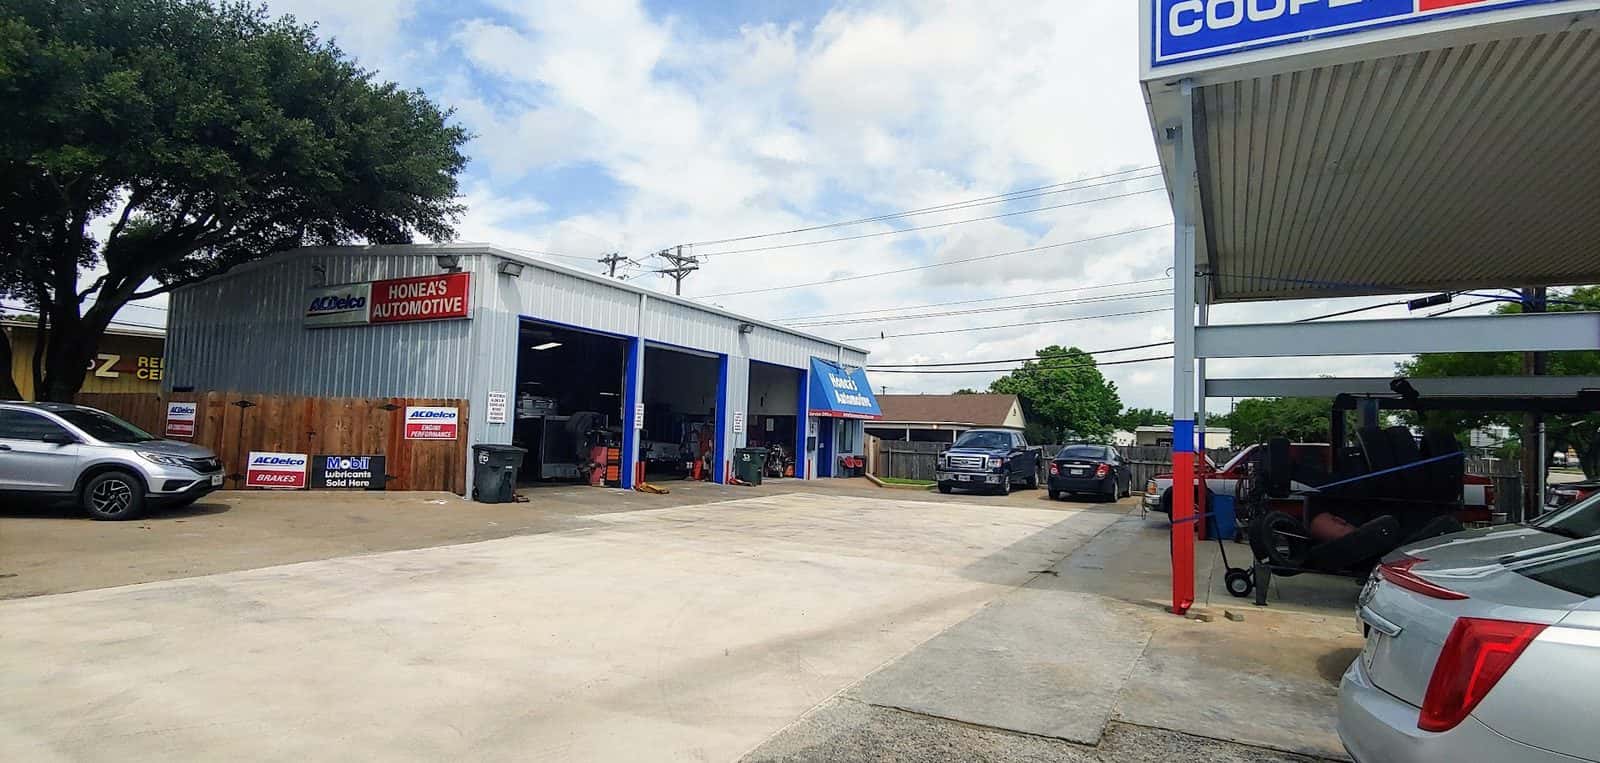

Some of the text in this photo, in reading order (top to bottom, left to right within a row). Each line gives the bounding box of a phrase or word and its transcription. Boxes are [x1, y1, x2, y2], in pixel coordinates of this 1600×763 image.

[389, 280, 447, 299] HONEA'S
[309, 294, 366, 311] ACDelco
[373, 297, 462, 318] AUTOMOTIVE
[828, 373, 857, 391] Honea's
[834, 389, 872, 408] Automotive
[253, 456, 304, 465] ACDelco
[326, 456, 370, 469] Mobil
[256, 473, 297, 483] BRAKES
[325, 470, 371, 479] Lubricants
[326, 479, 370, 487] Sold Here
